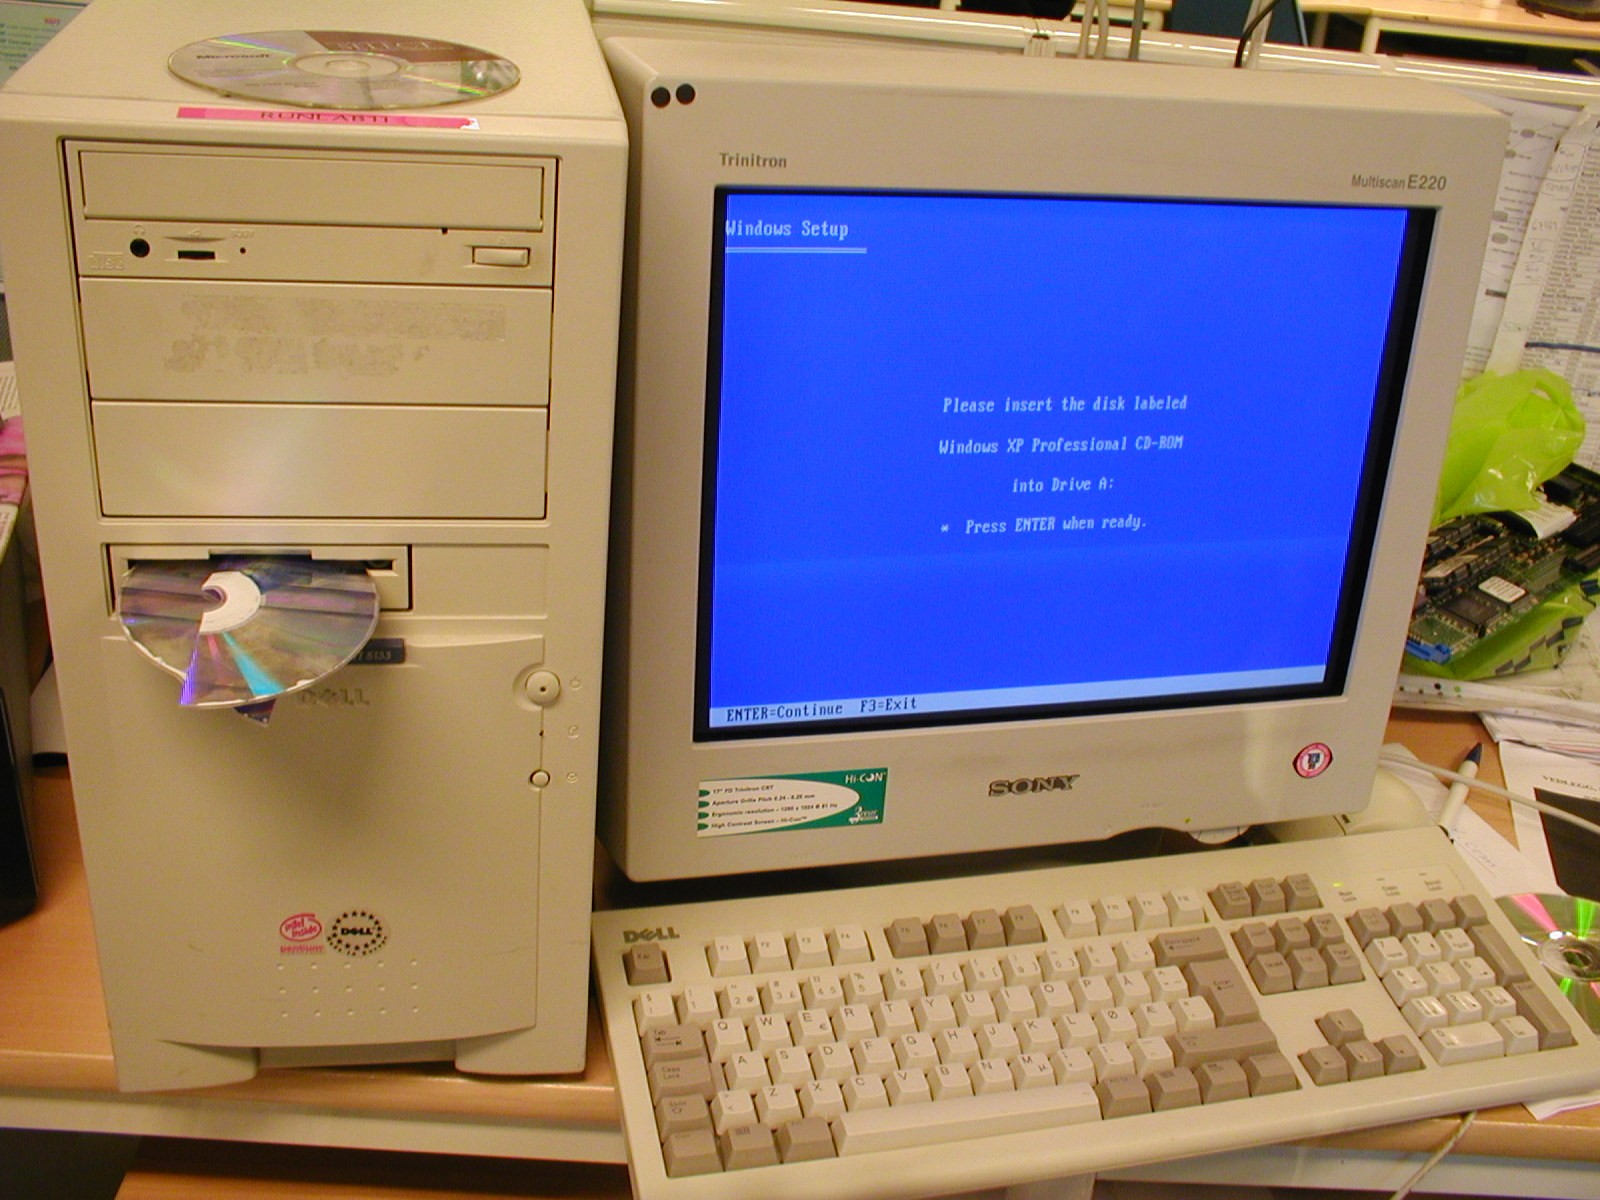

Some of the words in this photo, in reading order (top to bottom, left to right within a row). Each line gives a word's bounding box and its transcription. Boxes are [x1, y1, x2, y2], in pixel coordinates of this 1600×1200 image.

[719, 152, 787, 168] Trinitron
[1407, 174, 1447, 190] E220
[725, 220, 792, 236] Windows
[801, 220, 849, 240] Setup
[943, 397, 995, 413] Please
[1004, 396, 1053, 412] insert
[1062, 396, 1085, 411] the
[1093, 395, 1125, 411] disk
[1134, 394, 1188, 410] labeled
[938, 439, 999, 455] Windows
[1007, 438, 1025, 453] XP
[1031, 436, 1128, 452] Professional
[1135, 435, 1184, 450] CD-ROM
[1012, 477, 1044, 493] into
[1051, 476, 1091, 492] Drive
[1098, 477, 1114, 490] A:
[966, 519, 1007, 534] Press
[1015, 516, 1056, 532] ENTER
[1062, 515, 1095, 530] when
[1101, 514, 1147, 531] ready.
[300, 687, 371, 707] DELL
[726, 704, 844, 722] ENTER=Continue
[860, 697, 917, 713] F3=Exit
[989, 774, 1081, 797] SONY
[340, 928, 373, 936] DELL
[622, 926, 681, 944] DELL
[1083, 979, 1091, 988] P
[1123, 975, 1133, 986] Å
[1044, 984, 1054, 993] O
[925, 998, 934, 1007] Y
[965, 994, 975, 1003] U
[844, 1008, 854, 1017] R
[885, 1004, 893, 1012] T
[1146, 1005, 1157, 1013] Æ
[802, 1012, 812, 1022] E
[1108, 1010, 1118, 1019] Ø
[760, 1017, 773, 1026] W
[1027, 1020, 1038, 1029] K
[1066, 1016, 1076, 1025] L
[717, 1021, 728, 1030] Q
[947, 1030, 959, 1040] H
[989, 1026, 996, 1035] J
[906, 1036, 917, 1045] G
[864, 1041, 873, 1050] F
[780, 1050, 789, 1059] S
[823, 1046, 834, 1055] D
[738, 1056, 747, 1065] A
[1021, 1055, 1033, 1064] M
[981, 1061, 992, 1071] N
[897, 1071, 907, 1081] V
[855, 1077, 865, 1086] C
[769, 1087, 778, 1096] Z
[812, 1083, 822, 1091] X
